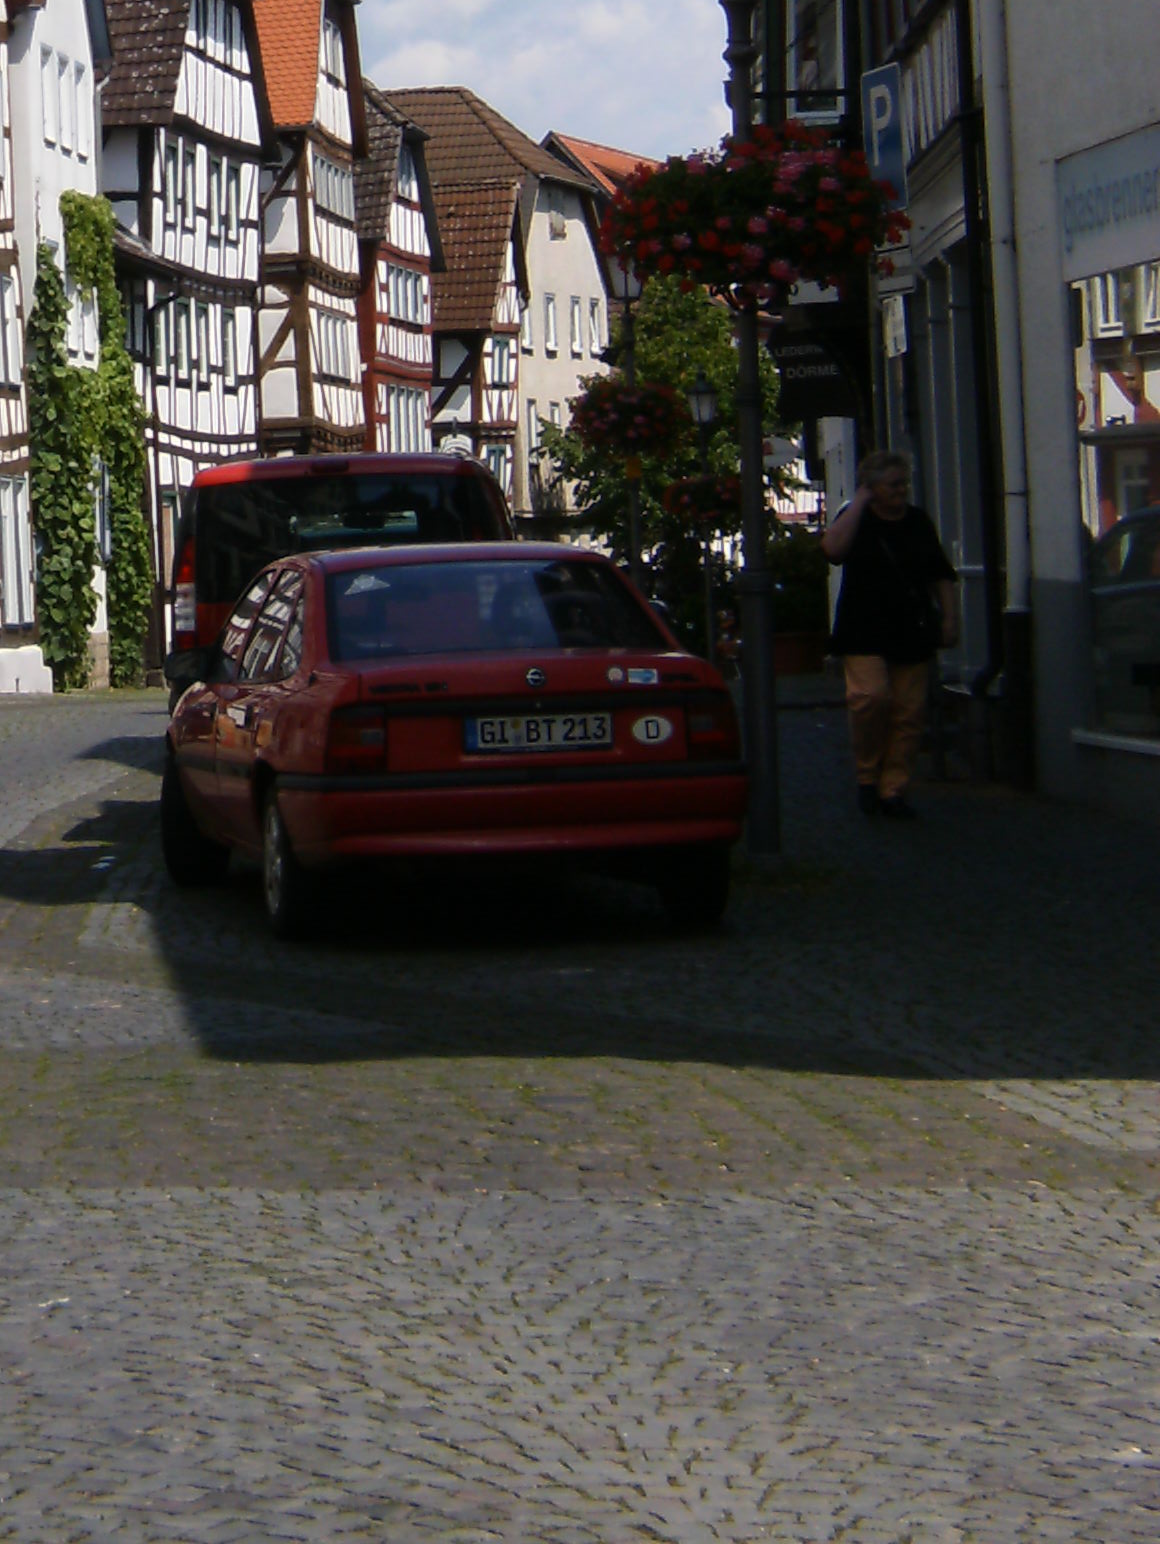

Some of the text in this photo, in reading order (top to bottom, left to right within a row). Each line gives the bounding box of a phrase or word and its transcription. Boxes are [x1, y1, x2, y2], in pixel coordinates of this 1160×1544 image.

[869, 83, 893, 167] P
[480, 716, 607, 744] GI BT 213
[645, 719, 660, 740] D
